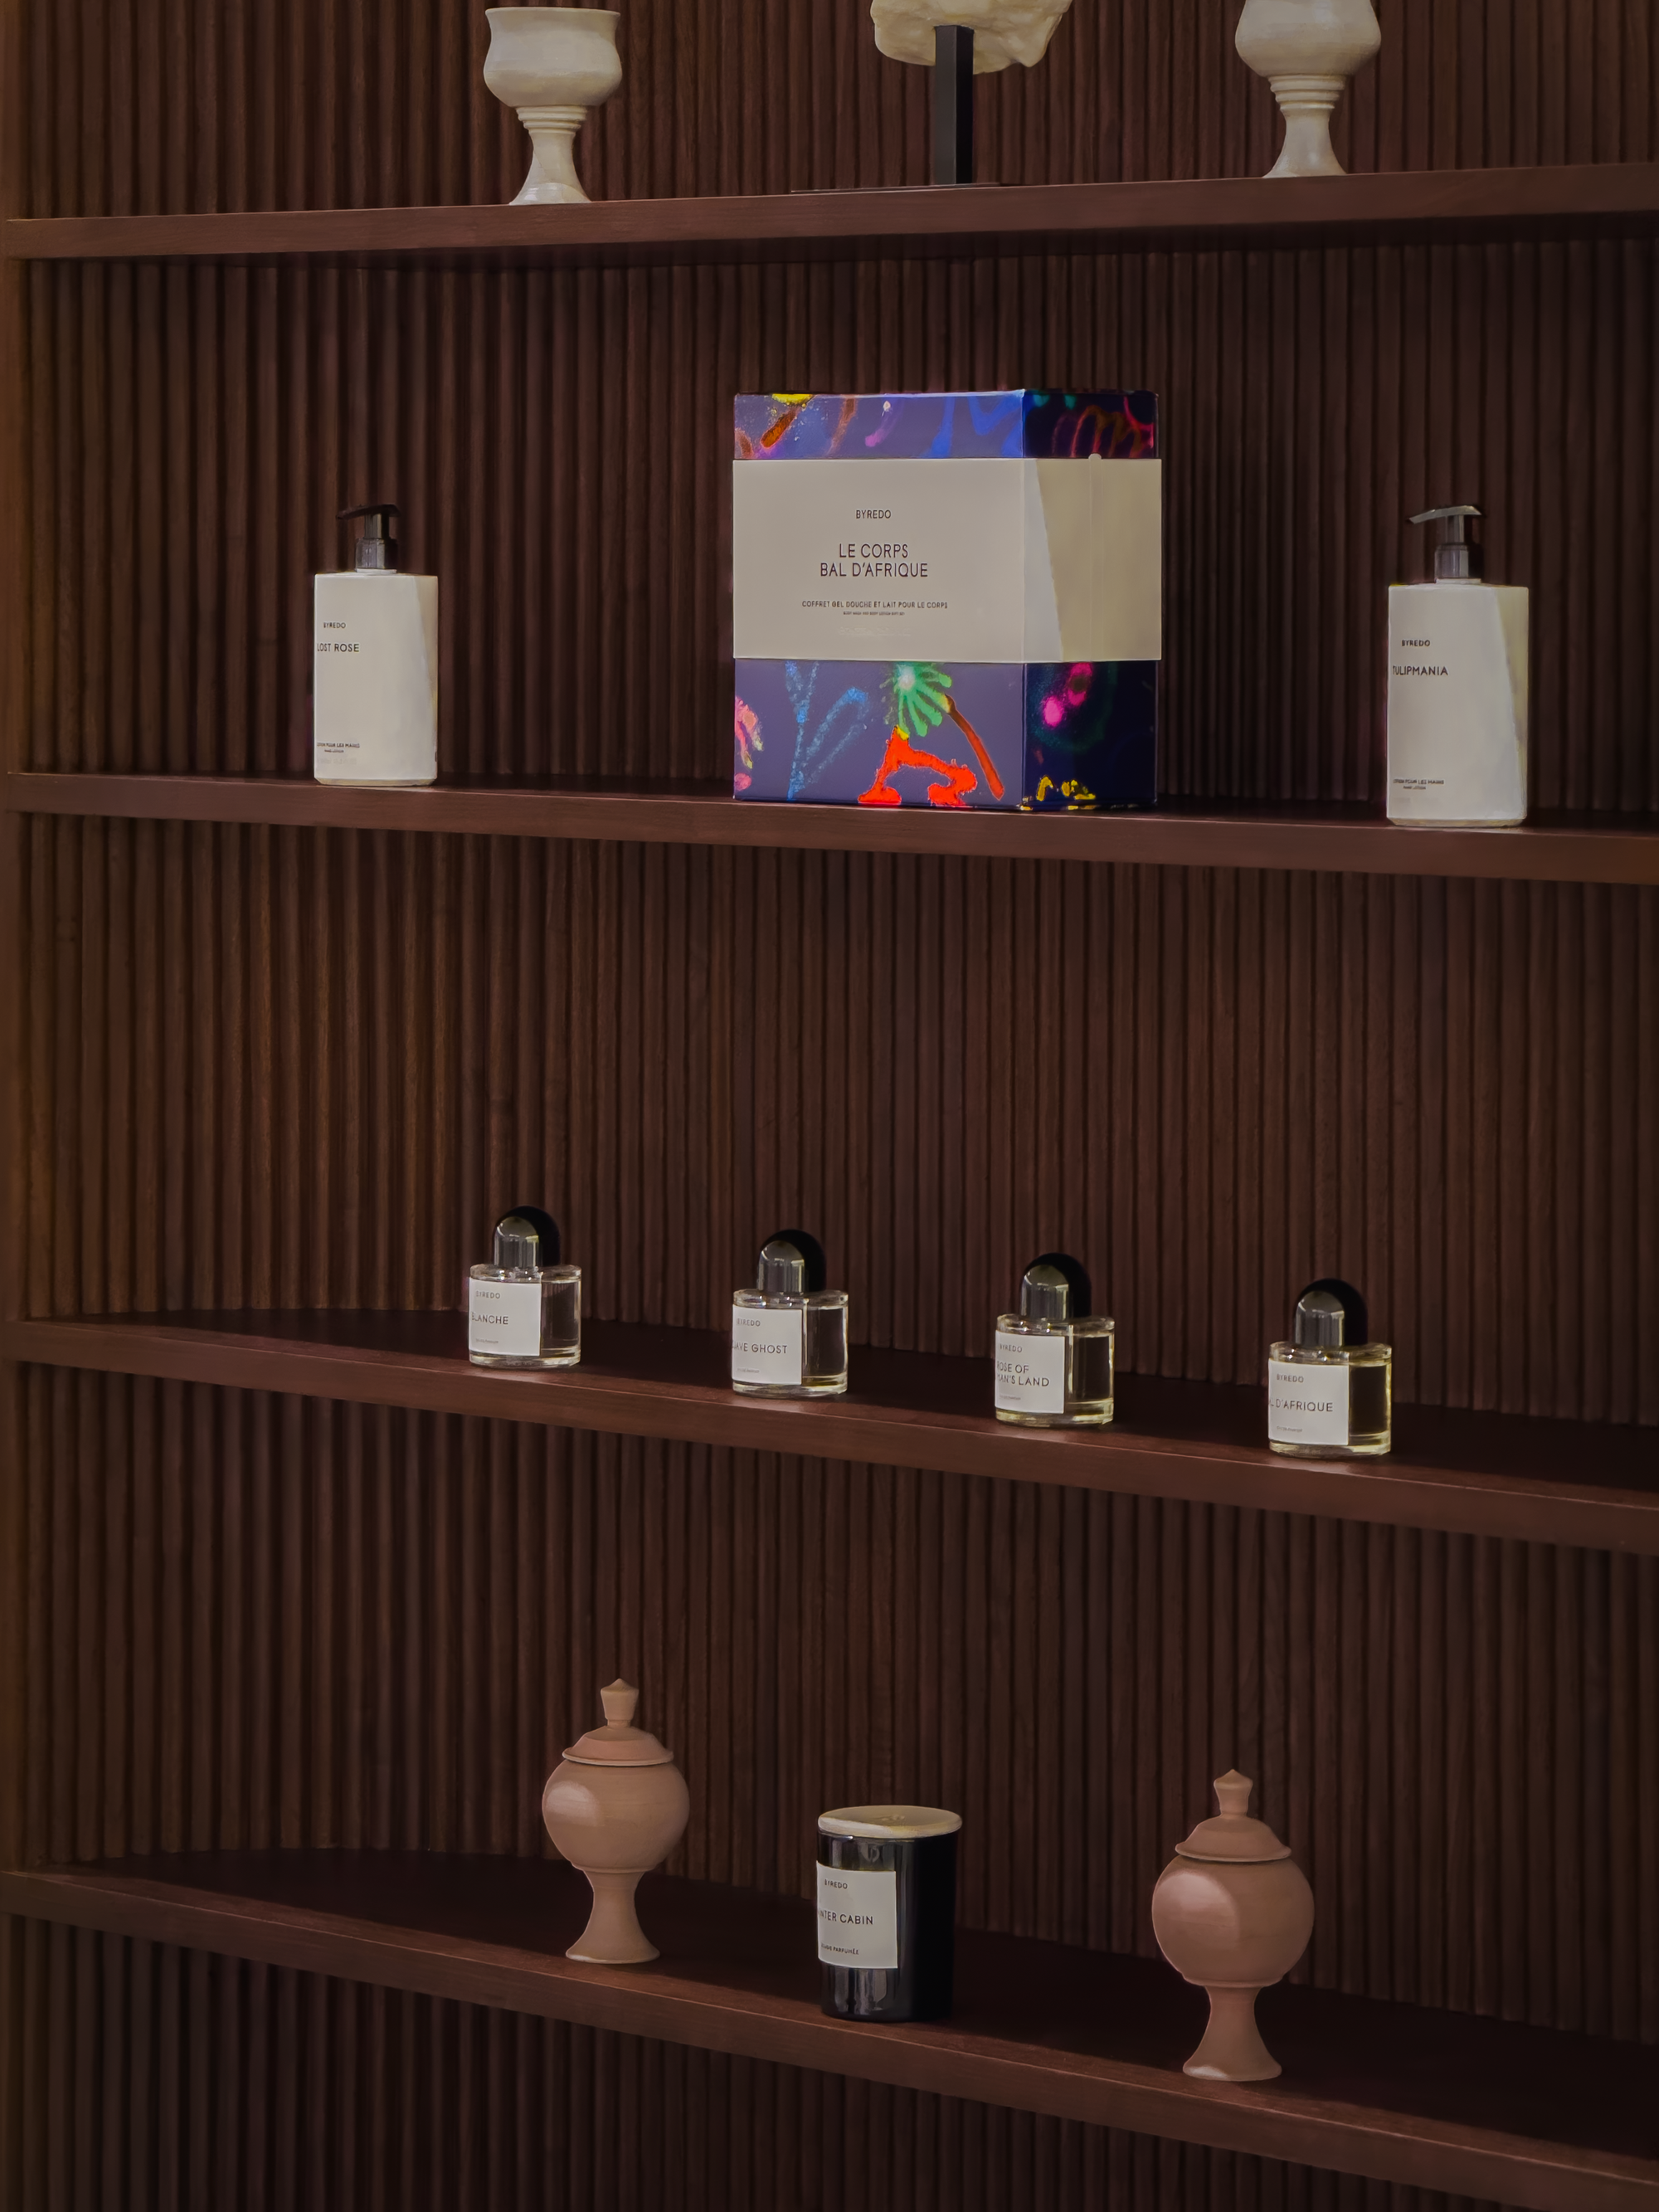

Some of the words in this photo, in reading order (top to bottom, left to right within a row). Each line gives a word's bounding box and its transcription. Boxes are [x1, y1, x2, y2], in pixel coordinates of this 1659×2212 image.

[855, 509, 892, 519] BYREDO
[839, 543, 855, 558] LE
[860, 543, 909, 558] CORPS
[820, 562, 846, 577] BAL
[852, 563, 928, 577] D'AFRIQUE
[317, 642, 331, 652] LOST
[334, 643, 359, 652] ROSE
[1393, 665, 1448, 676] TULIPMANIA
[752, 1343, 788, 1354] GHOST
[1014, 1364, 1029, 1374] OF
[1019, 1376, 1049, 1387] LAND
[1276, 1398, 1333, 1412] D'AFRIQUE
[839, 1913, 873, 1925] CABIN
